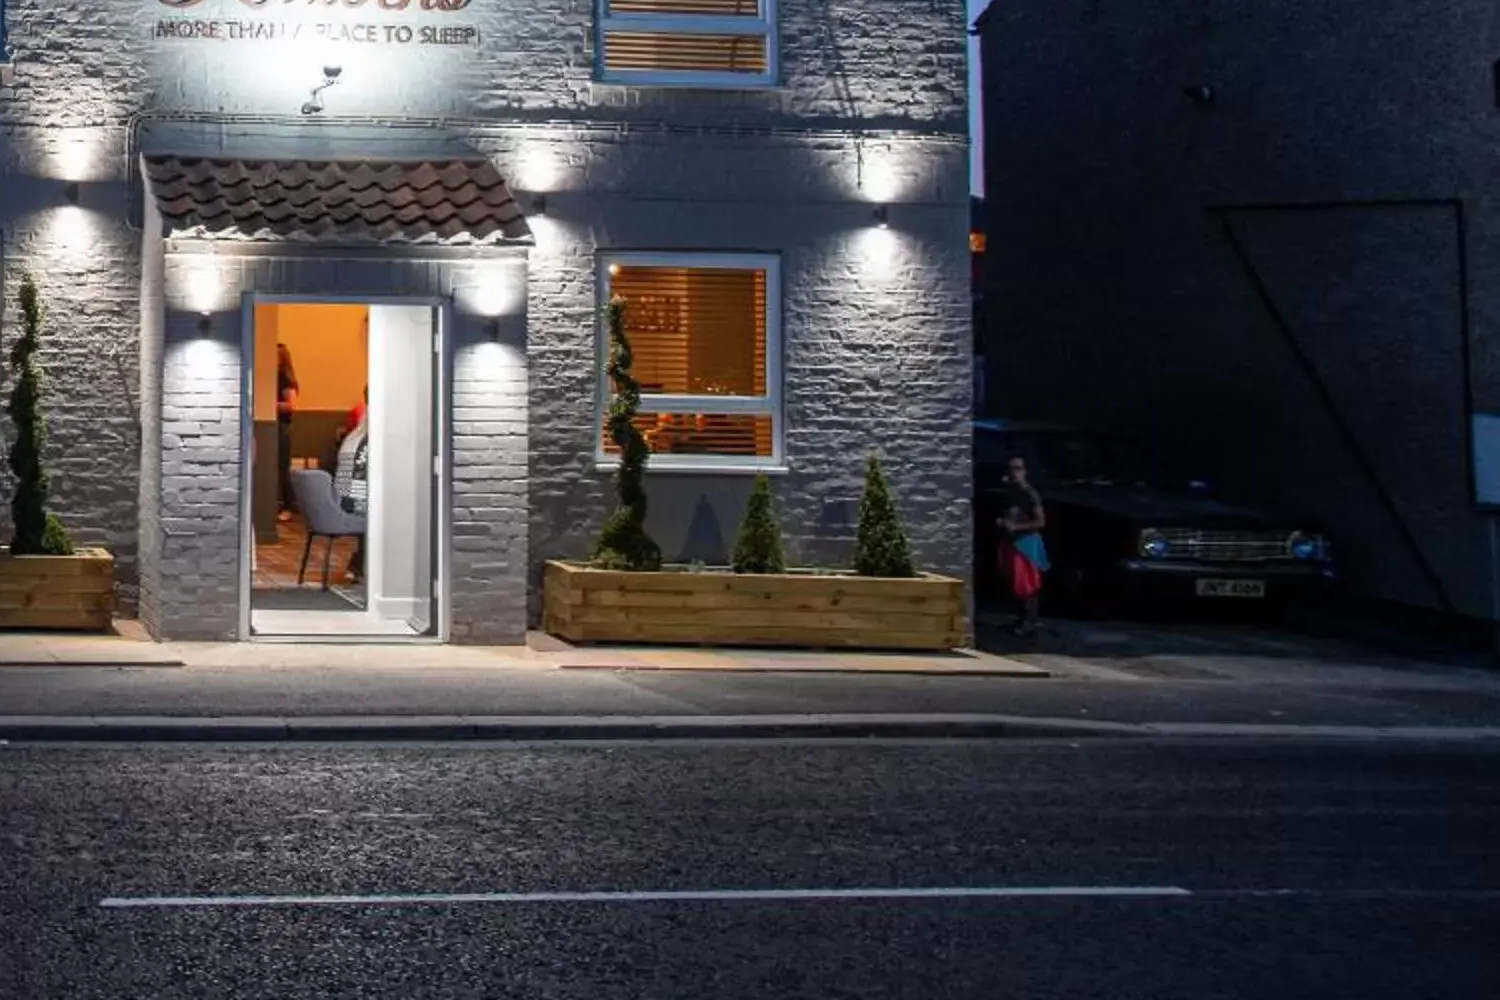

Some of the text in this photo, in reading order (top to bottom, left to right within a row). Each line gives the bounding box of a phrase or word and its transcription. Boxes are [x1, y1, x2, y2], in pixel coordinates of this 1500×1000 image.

[156, 19, 222, 39] MORE
[315, 23, 378, 42] PLACE
[383, 25, 413, 43] TO
[419, 25, 476, 45] SLEEP
